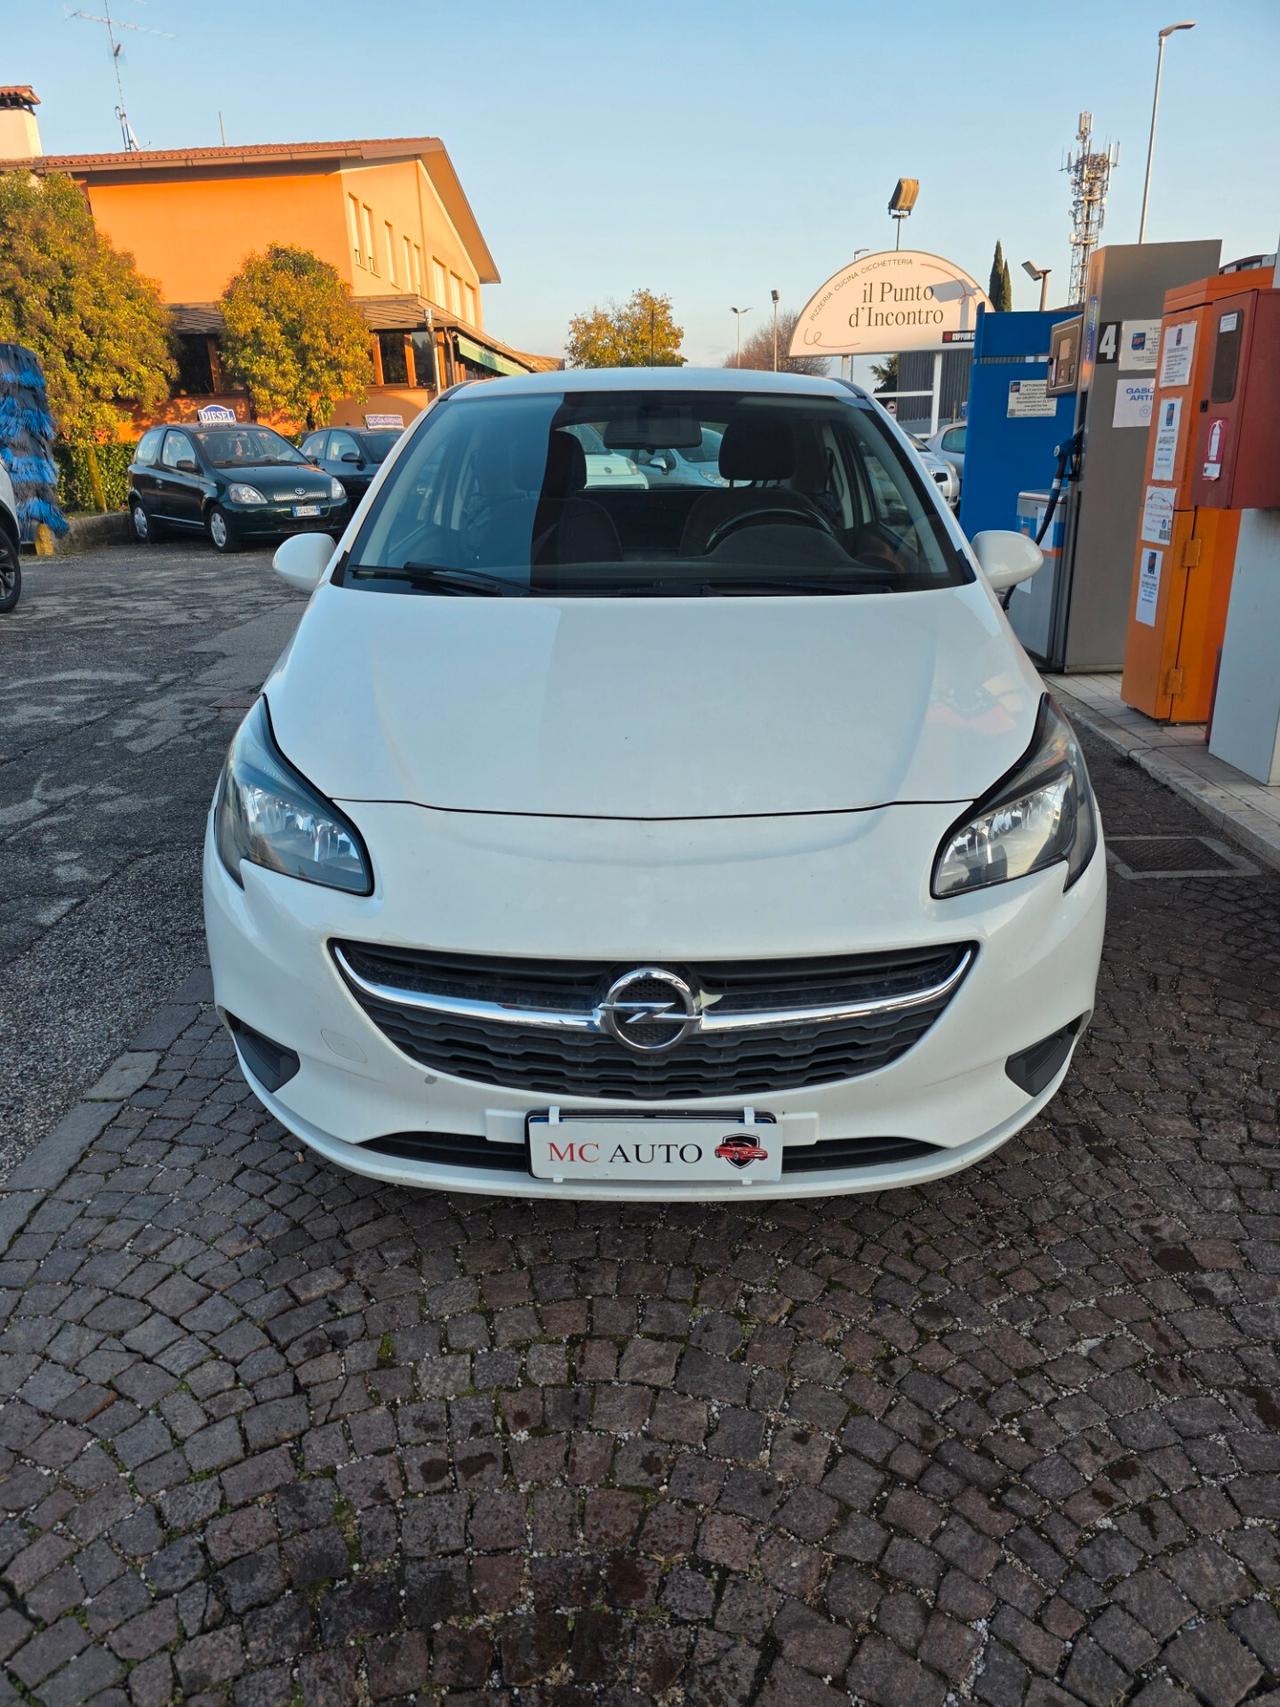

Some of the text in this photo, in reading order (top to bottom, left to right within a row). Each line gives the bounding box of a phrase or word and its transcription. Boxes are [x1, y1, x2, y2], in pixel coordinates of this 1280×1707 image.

[809, 258, 913, 321] PIZZERIA CUCINA CICCHETTERIA
[863, 281, 934, 303] il Punto
[848, 307, 944, 328] d'Incontro
[1099, 324, 1117, 360] 4
[200, 410, 235, 422] DIESEL
[546, 1141, 703, 1165] MC AUTO
